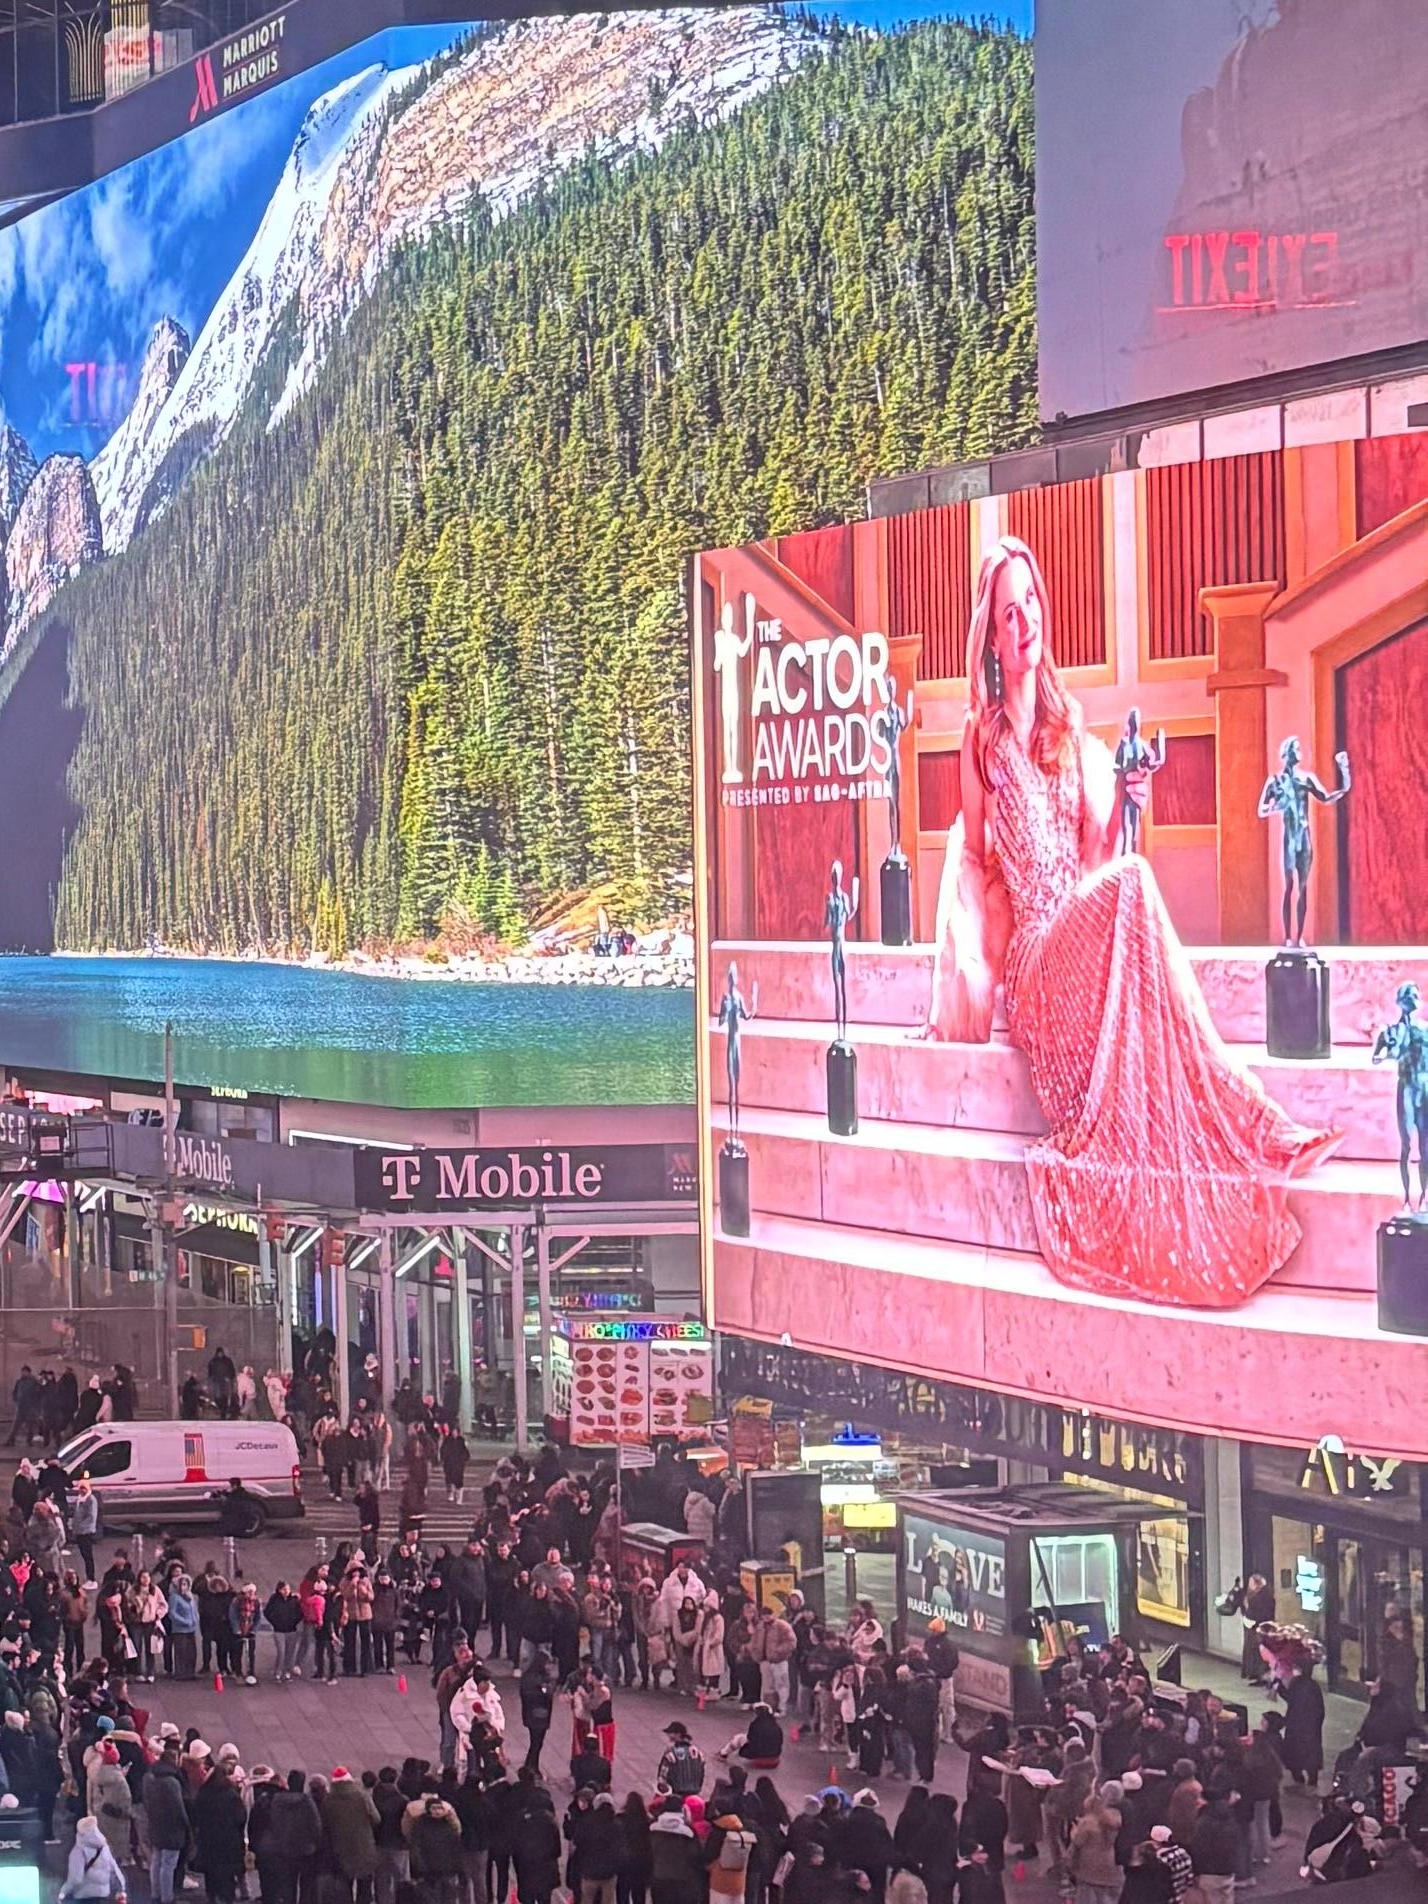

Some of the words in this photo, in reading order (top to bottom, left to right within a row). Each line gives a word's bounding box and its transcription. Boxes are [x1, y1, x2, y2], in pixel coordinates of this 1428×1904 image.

[223, 16, 286, 67] MARRIOTT
[224, 49, 279, 97] MARQUIS
[756, 618, 782, 642] THE
[751, 632, 891, 716] ACTOR
[752, 709, 892, 788] AWARDS
[722, 787, 790, 807] PRESENTED
[794, 785, 810, 804] BY
[176, 1137, 234, 1184] Mobile
[382, 1156, 420, 1200] T
[435, 1152, 602, 1200] Mobile
